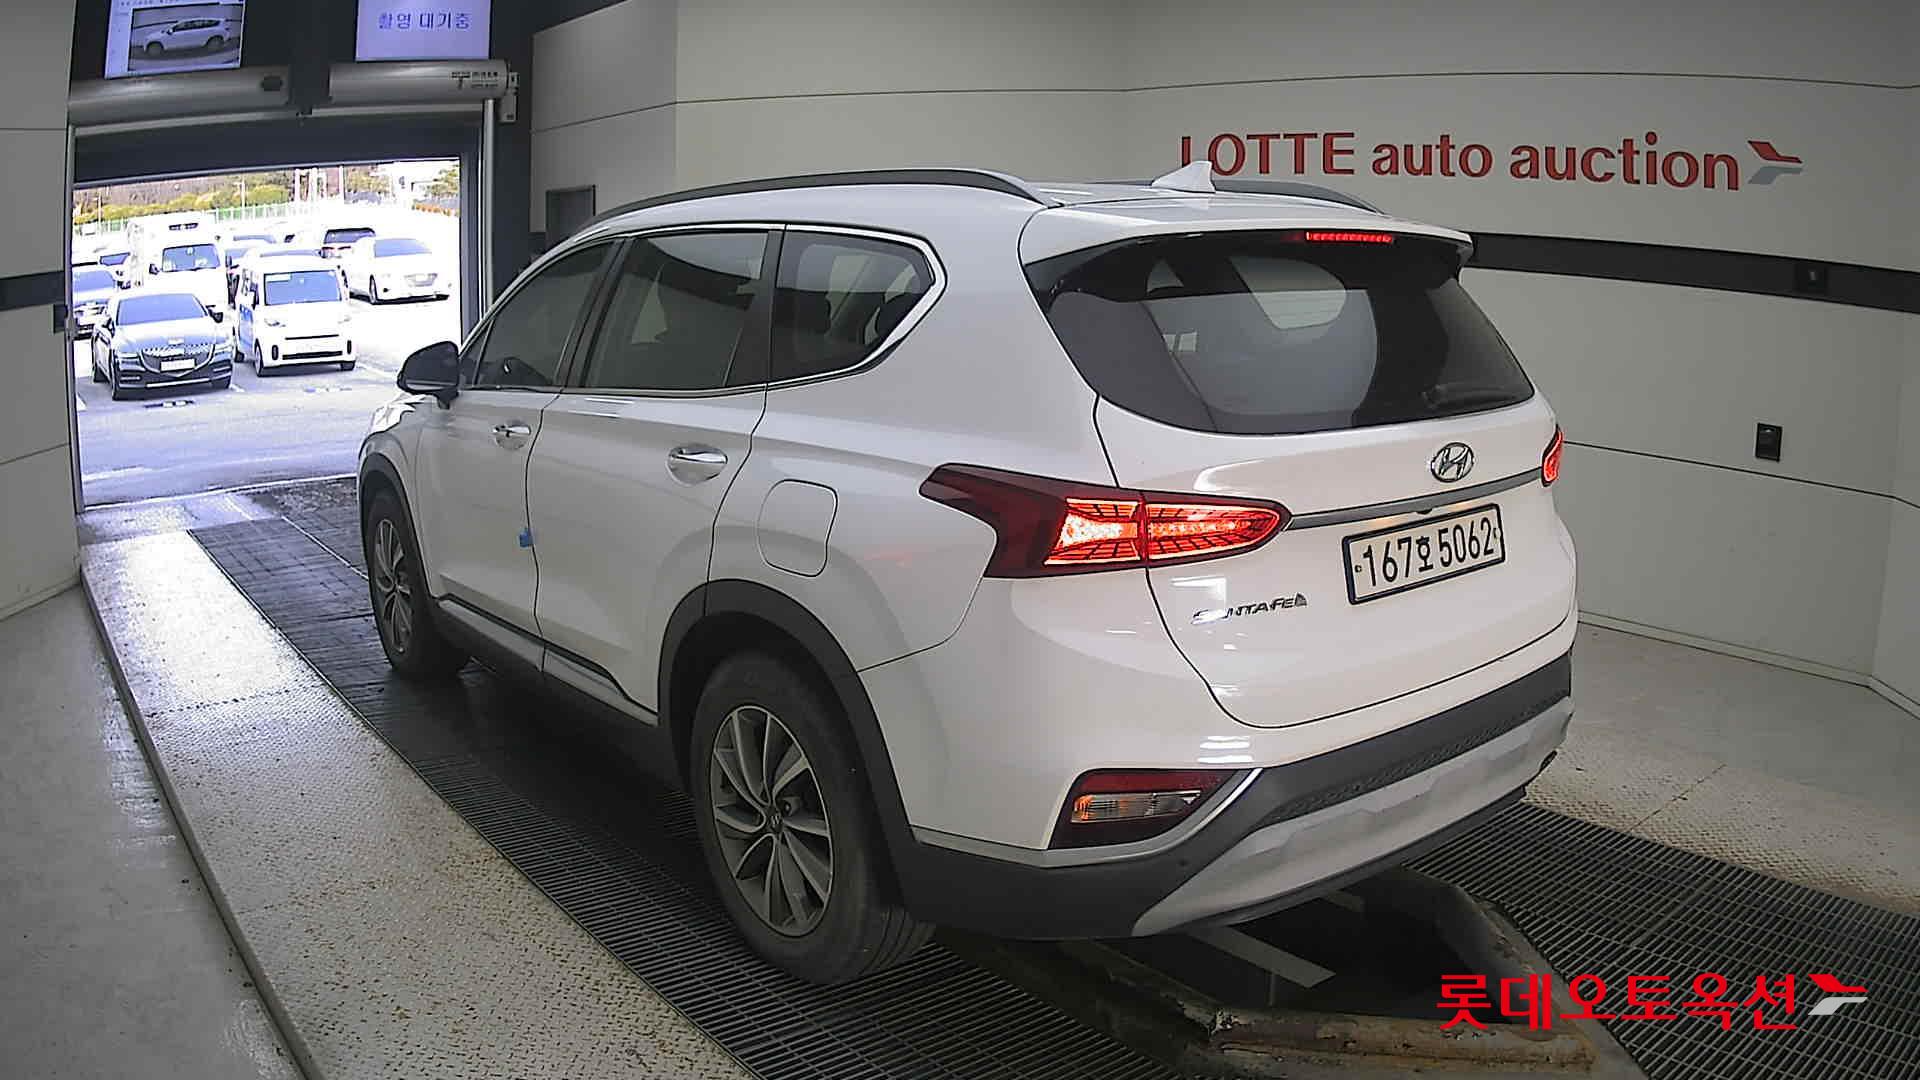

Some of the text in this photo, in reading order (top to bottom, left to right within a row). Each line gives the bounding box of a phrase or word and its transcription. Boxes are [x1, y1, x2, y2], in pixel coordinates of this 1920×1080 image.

[418, 11, 470, 30] 대기중
[1371, 134, 1493, 177] auto
[1509, 131, 1740, 191] auction
